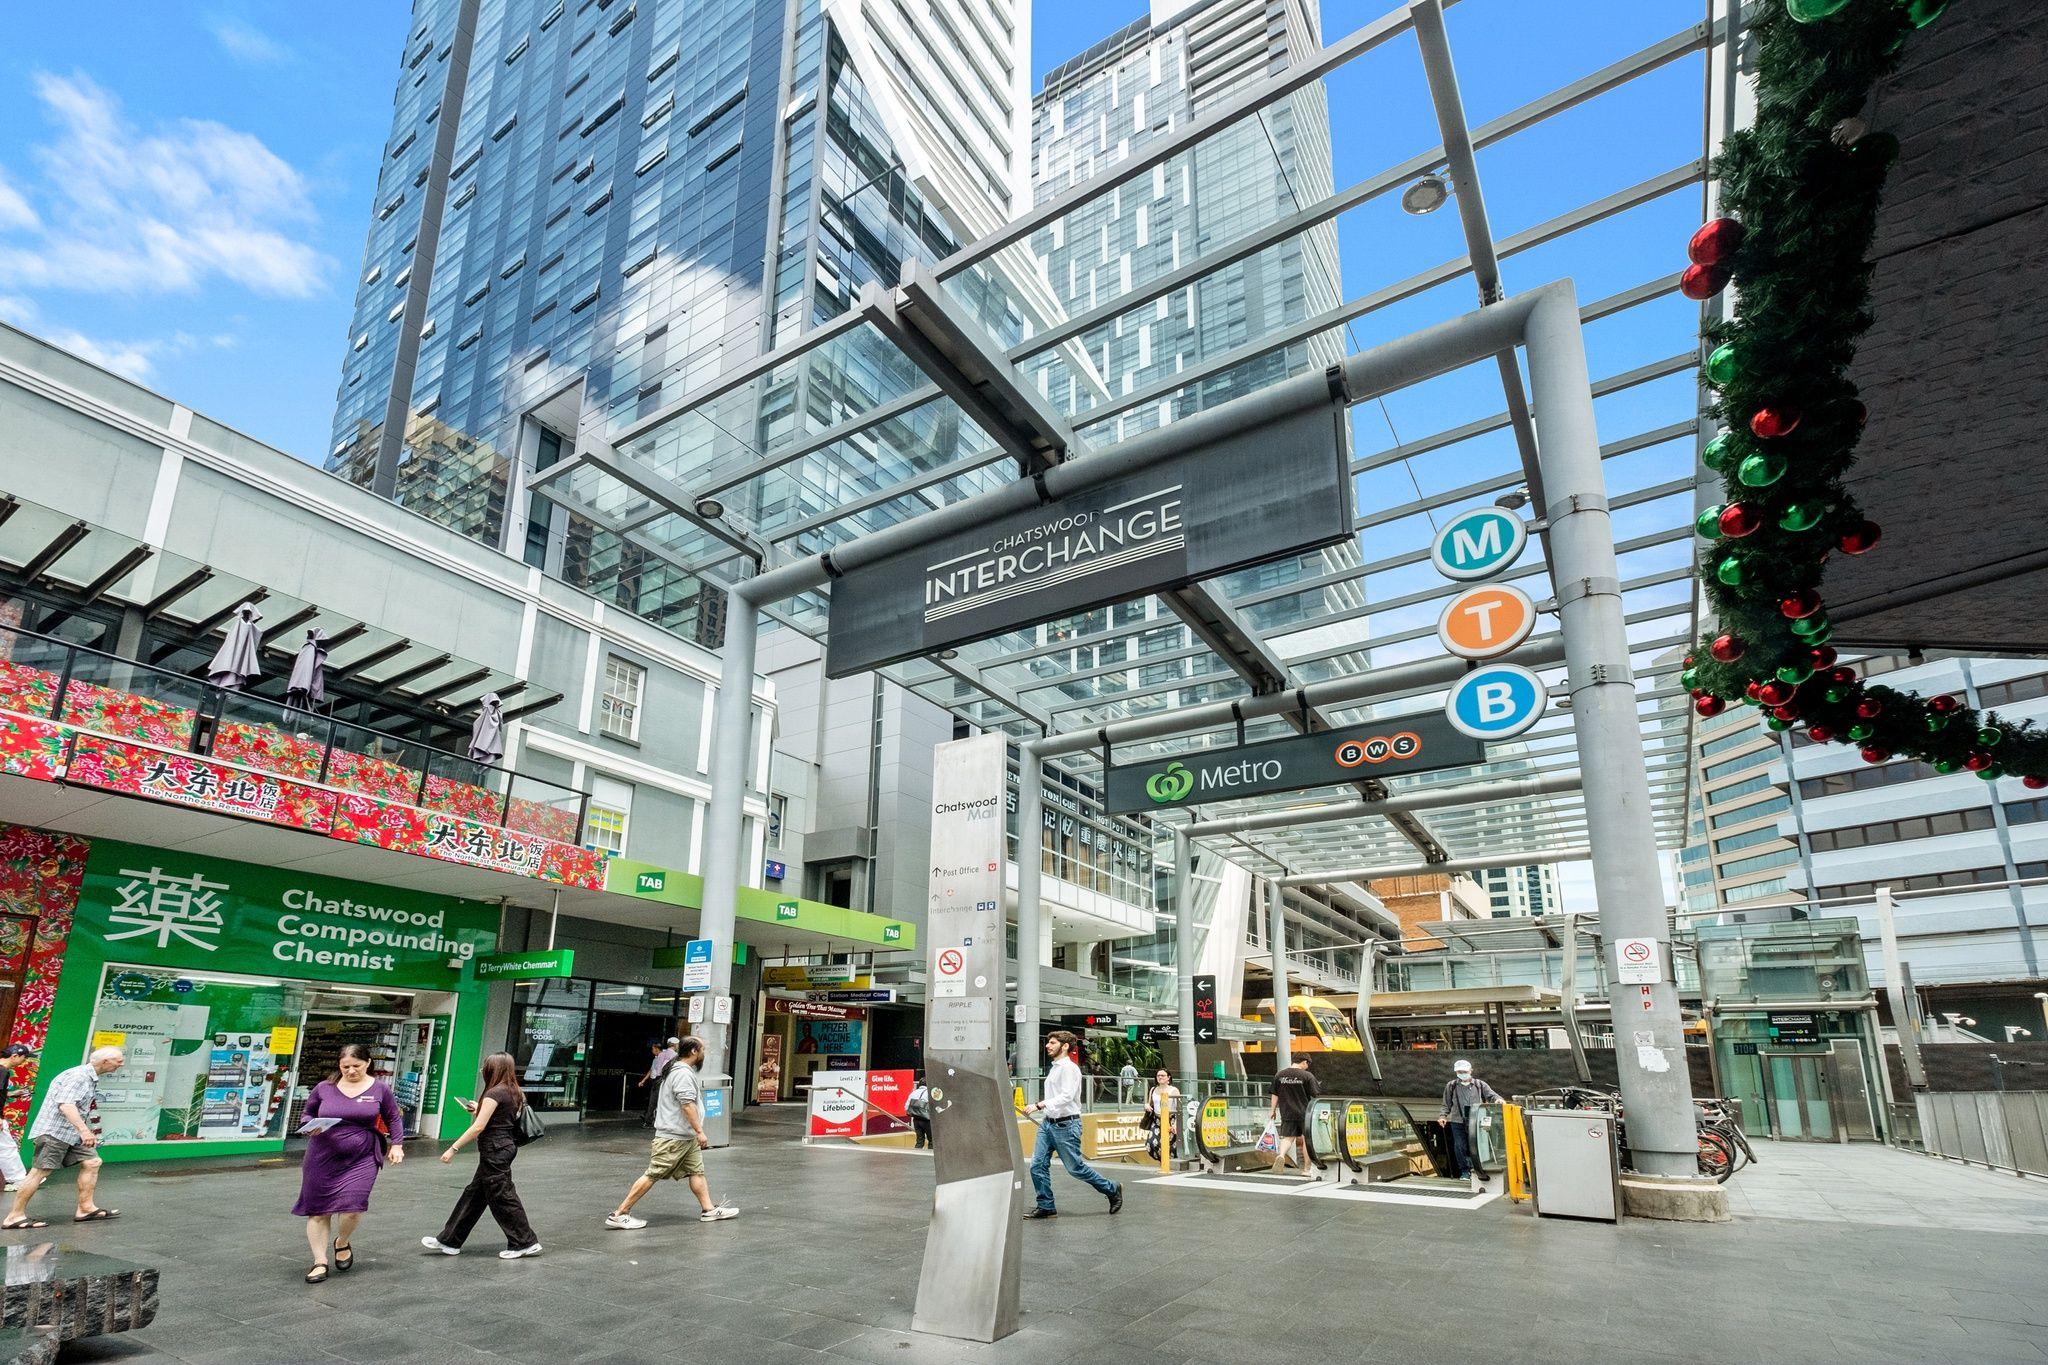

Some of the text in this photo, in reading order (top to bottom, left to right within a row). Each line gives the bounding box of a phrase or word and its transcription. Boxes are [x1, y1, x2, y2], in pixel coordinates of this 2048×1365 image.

[1452, 519, 1502, 565] M
[925, 500, 1183, 605] INTERCHANGE
[1464, 600, 1502, 641] T
[1476, 681, 1516, 723] B
[1200, 759, 1282, 790] Metro
[141, 786, 271, 818] The Northeast Restaurant
[935, 795, 998, 815] Chatswood
[966, 806, 997, 822] Mall
[1096, 814, 1108, 826] HOT
[1112, 822, 1124, 834] POT
[438, 849, 529, 872] The Northeast Restaurant
[942, 865, 980, 878] Post Office
[639, 875, 663, 890] TAB
[281, 889, 445, 929] Chatswood
[779, 904, 797, 917] TAB
[930, 904, 973, 915] Interchange
[277, 914, 475, 960] Compounding
[885, 927, 900, 939] TAB
[272, 940, 395, 972] Chemist
[487, 960, 558, 973] TerryWhite Chemmart
[1641, 986, 1650, 995] H
[788, 1001, 806, 1009] Golden
[827, 1006, 847, 1015] Massage
[949, 1001, 973, 1009] RIPPLE
[1643, 1001, 1652, 1010] P
[821, 1022, 848, 1033] PFIZER
[818, 1032, 851, 1043] VACCINE
[823, 1042, 845, 1053] HERE
[822, 1104, 855, 1112] Lifeblood
